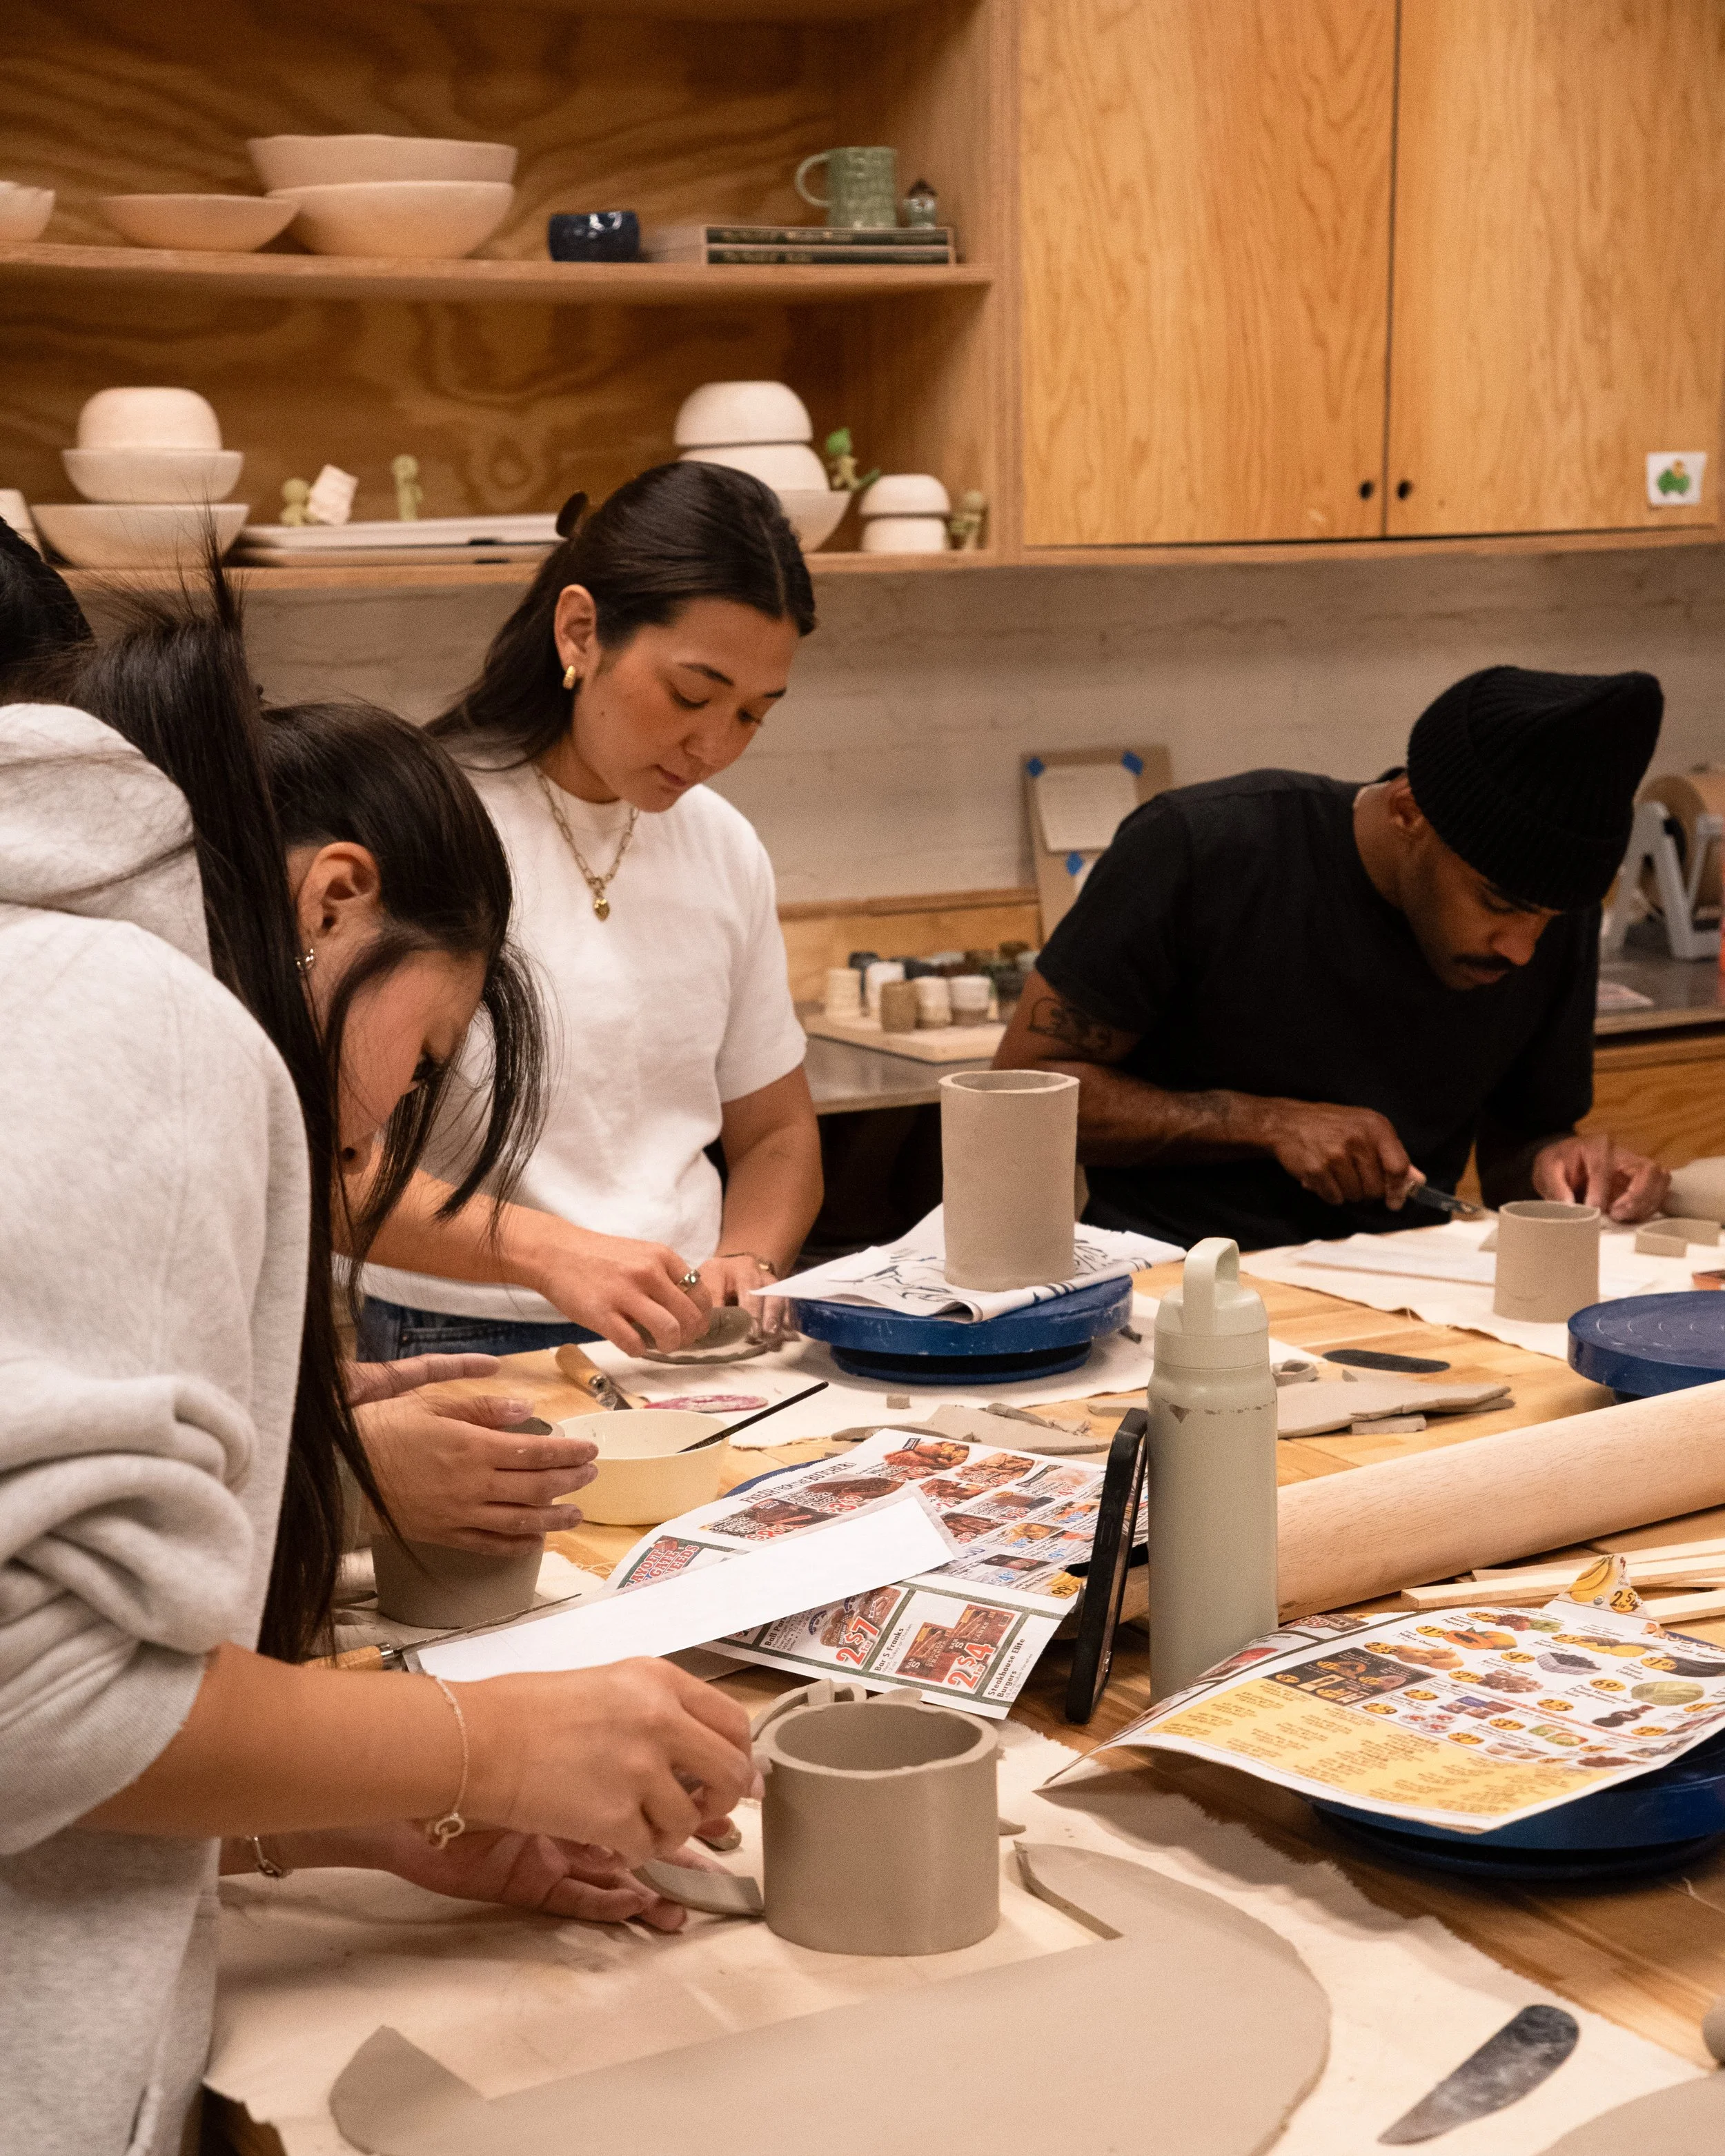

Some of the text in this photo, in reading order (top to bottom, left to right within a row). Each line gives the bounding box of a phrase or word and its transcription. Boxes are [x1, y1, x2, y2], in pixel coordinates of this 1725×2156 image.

[740, 1488, 776, 1504] FRESH
[805, 1461, 856, 1483] BUTCHER!
[1610, 1590, 1622, 1607] 2
[846, 1616, 879, 1645] $7
[973, 1620, 989, 1642] RANKS
[1417, 1626, 1450, 1636] $199
[1439, 1619, 1465, 1627] Papaya
[764, 1631, 777, 1647] Ball
[771, 1623, 789, 1648] Hamburger
[776, 1626, 793, 1650] Everything
[782, 1636, 792, 1650] White
[889, 1645, 900, 1660] Turkey
[900, 1622, 913, 1641] Chicken
[949, 1637, 958, 1650] BAR
[955, 1639, 964, 1649] S
[787, 1639, 796, 1652] Butter
[860, 1640, 873, 1652] For
[874, 1657, 887, 1672] Bar
[885, 1625, 905, 1652] Franks
[836, 1648, 864, 1665] 2
[905, 1656, 916, 1670] BAR
[911, 1659, 921, 1669] S
[948, 1642, 994, 1689] 2 For $4
[987, 1636, 1025, 1697] Steakhouse Elite
[996, 1669, 1018, 1699] Burgers
